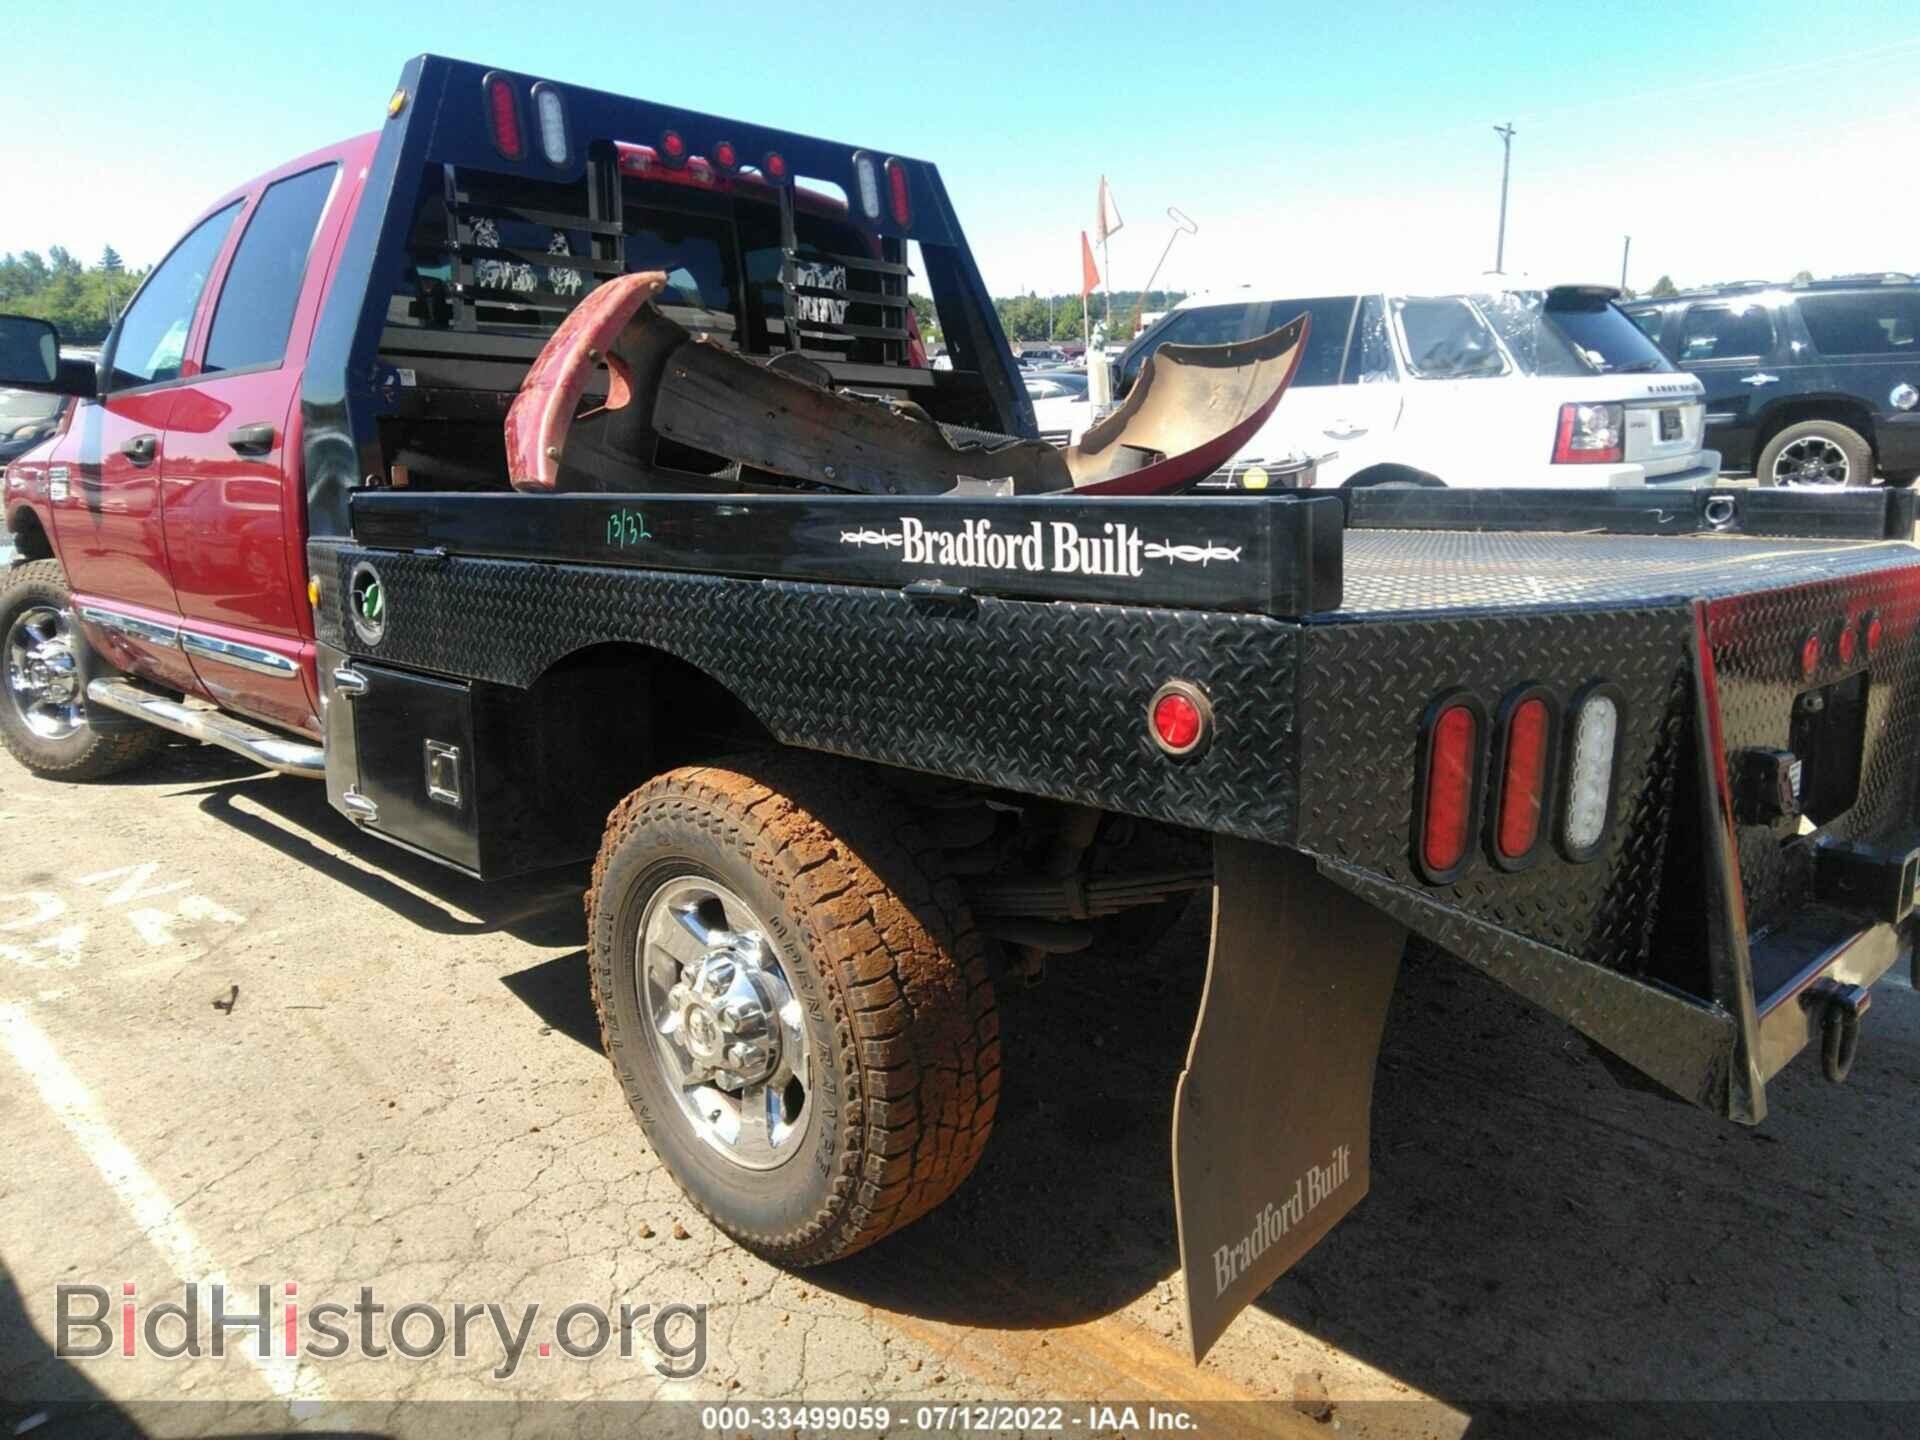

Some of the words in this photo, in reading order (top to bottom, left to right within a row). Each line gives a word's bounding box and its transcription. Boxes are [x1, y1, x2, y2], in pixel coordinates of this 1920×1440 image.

[899, 516, 1045, 572] Bradford
[1050, 521, 1144, 578] Built
[1212, 1178, 1305, 1298] Bradford
[1307, 1144, 1352, 1213] Built
